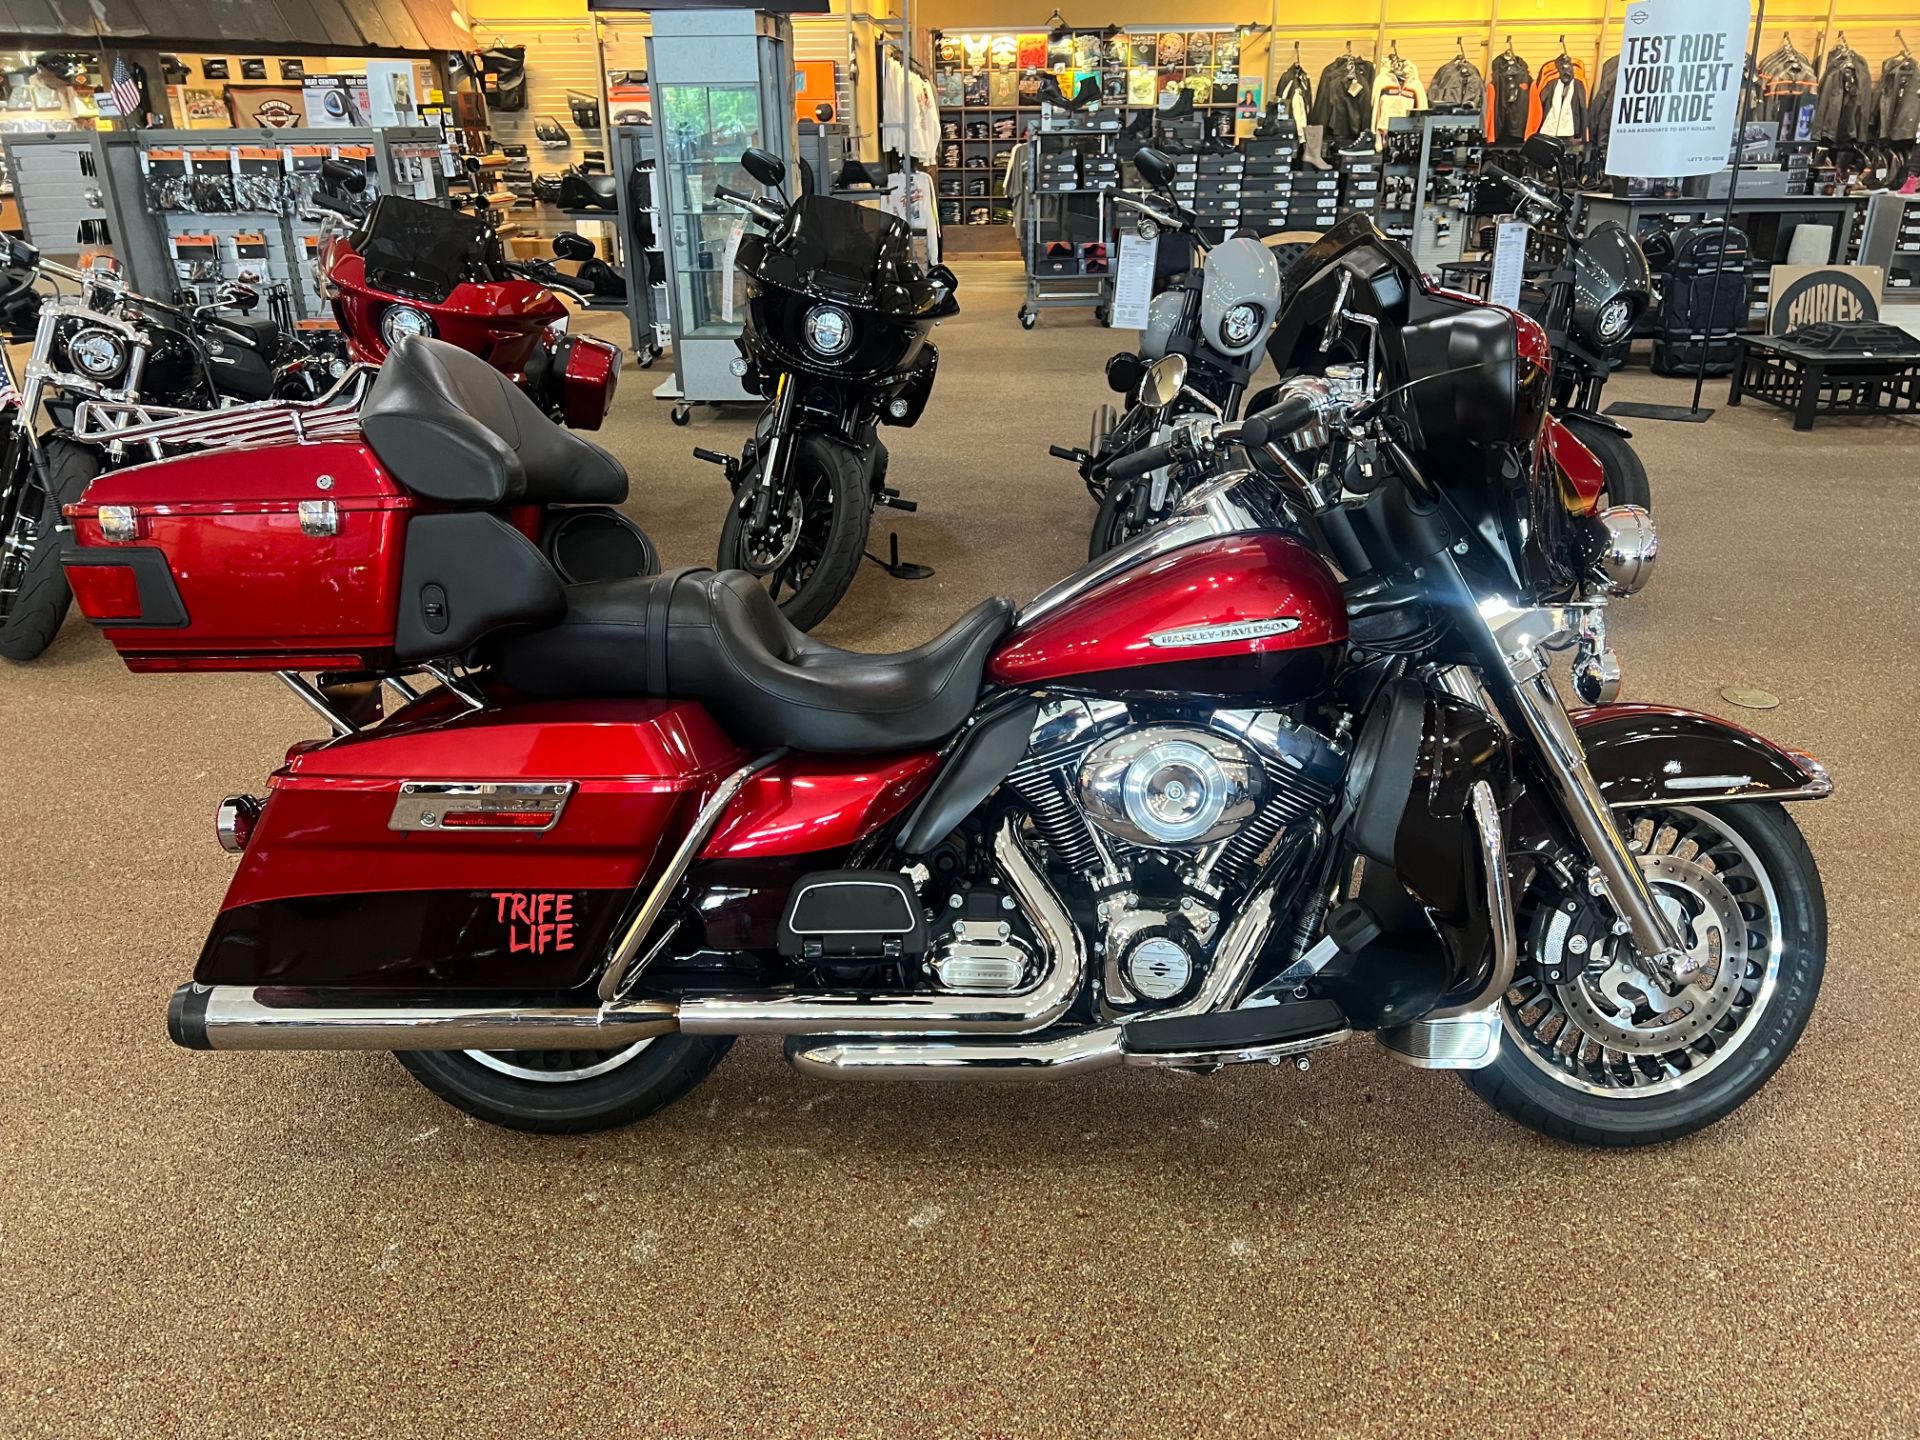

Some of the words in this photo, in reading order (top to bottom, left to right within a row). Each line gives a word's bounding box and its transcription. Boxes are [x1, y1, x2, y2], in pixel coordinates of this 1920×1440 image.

[1628, 35, 1676, 65] TEST
[1678, 33, 1727, 63] RIDE
[1624, 65, 1675, 94] YOUR
[1678, 63, 1733, 93] NEXT
[1618, 95, 1665, 124] NEW
[1667, 94, 1715, 122] RIDE
[1789, 283, 1864, 326] HARLEY
[1161, 621, 1290, 644] HARLEY-DAVIDSON
[491, 892, 574, 925] TRIFE
[509, 923, 574, 955] LIFE
